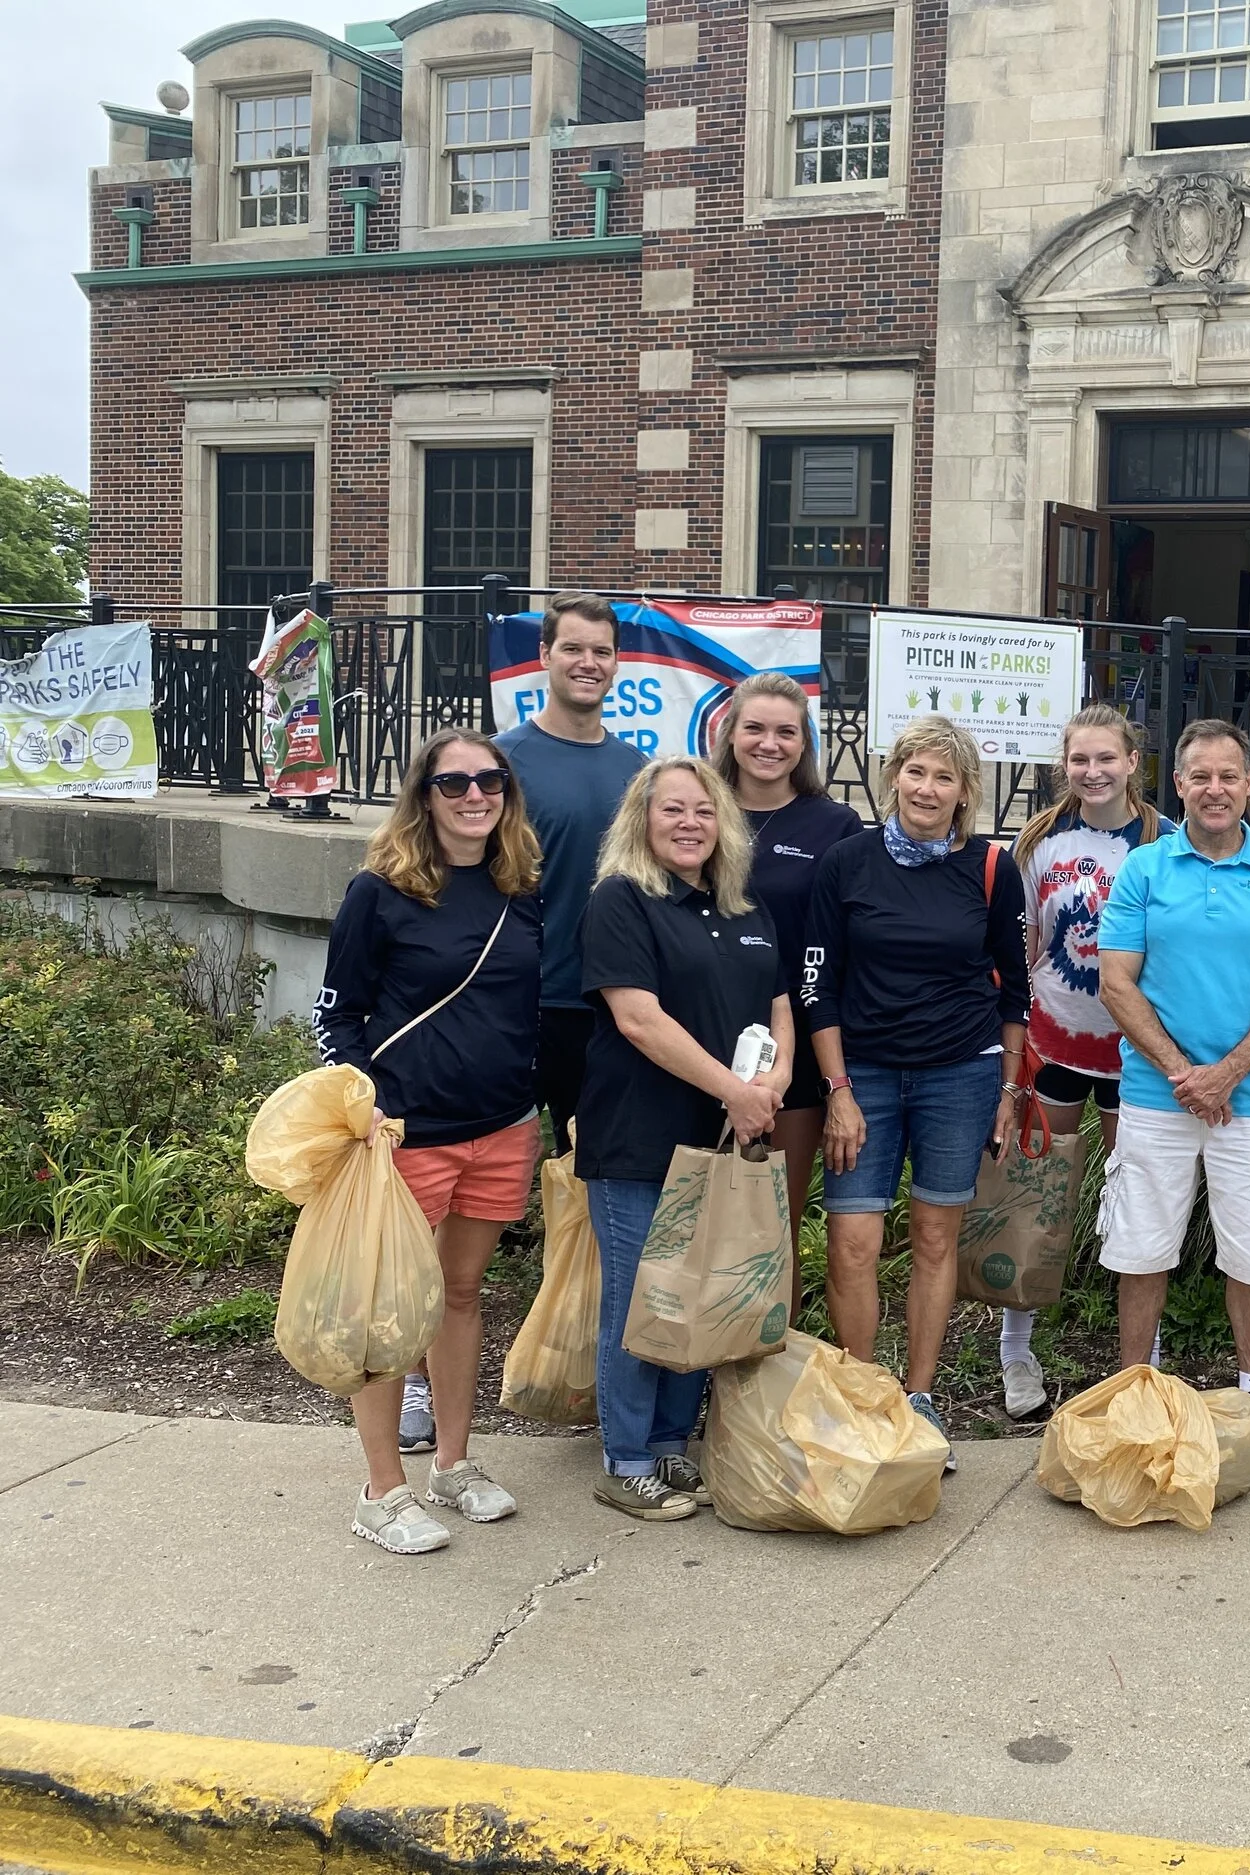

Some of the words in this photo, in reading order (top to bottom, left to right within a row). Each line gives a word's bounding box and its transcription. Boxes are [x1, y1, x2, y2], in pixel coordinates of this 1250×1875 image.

[695, 610, 739, 620] CHICAGO
[741, 612, 765, 620] PARK
[766, 610, 809, 620] DISTRICT
[901, 629, 921, 639] This
[922, 631, 946, 642] park
[948, 632, 956, 641] is
[959, 633, 997, 646] lovingly
[999, 636, 1025, 646] cared
[1026, 638, 1042, 649] for
[1044, 639, 1055, 650] by
[43, 641, 85, 672] THE
[906, 646, 954, 668] PITCH
[960, 650, 976, 670] IN
[991, 652, 1051, 675] PARKS!
[0, 677, 62, 704] PARKS
[68, 661, 141, 699] SAFELY
[944, 676, 977, 684] VOLUNTEER
[515, 678, 663, 725] FIESS
[1044, 871, 1074, 883] WEST
